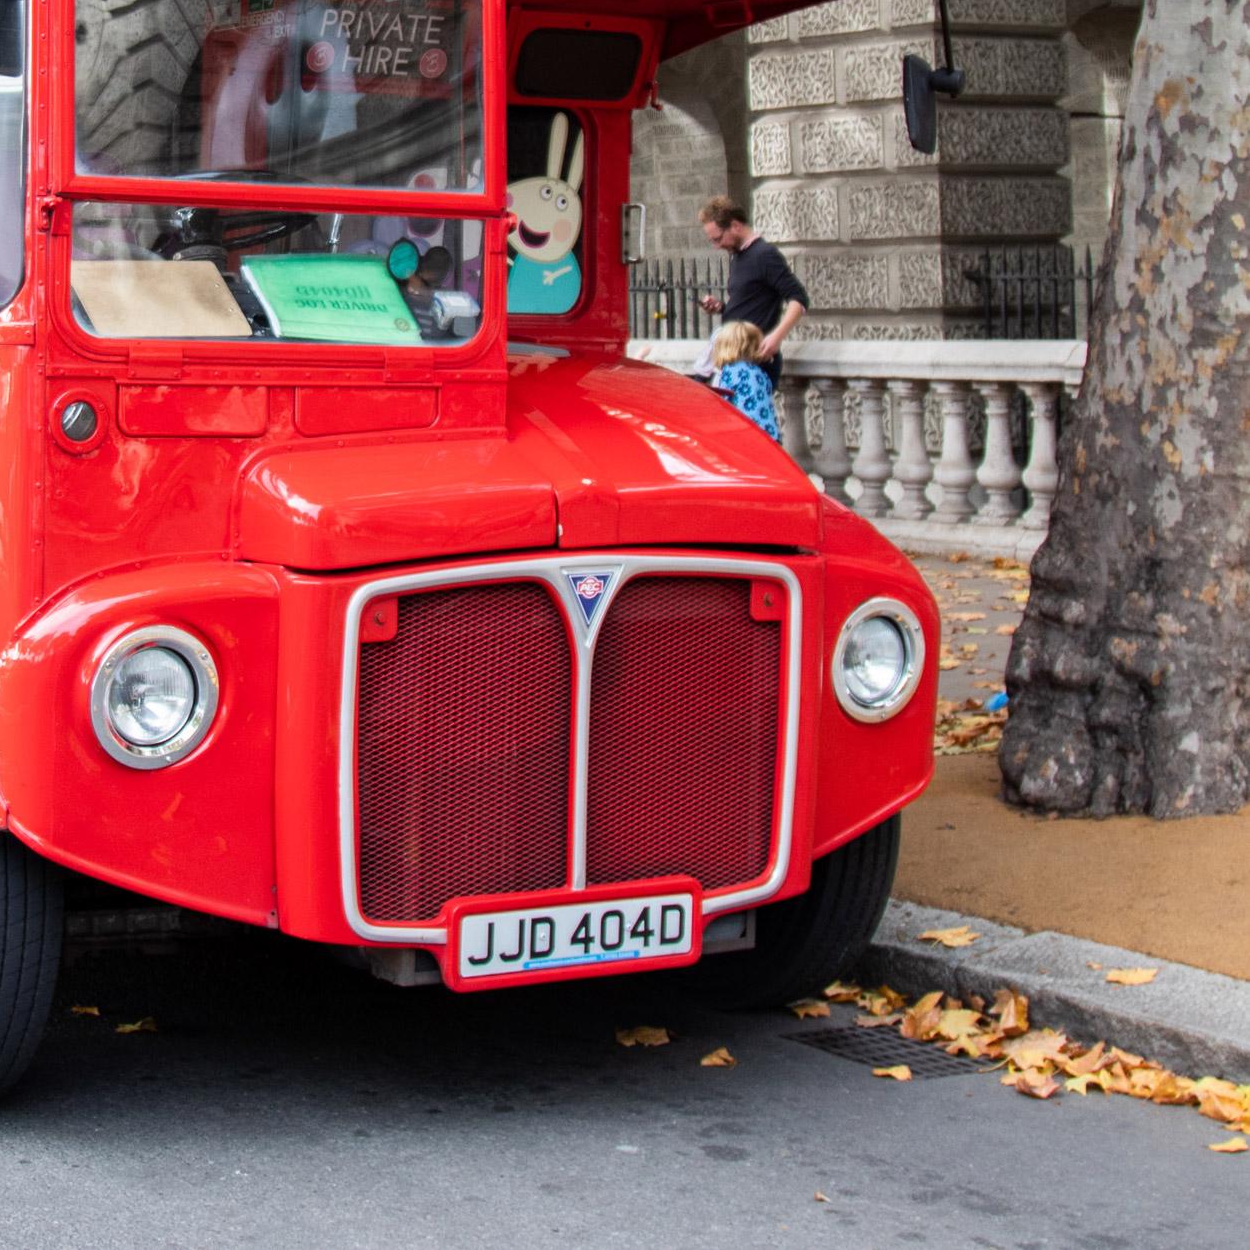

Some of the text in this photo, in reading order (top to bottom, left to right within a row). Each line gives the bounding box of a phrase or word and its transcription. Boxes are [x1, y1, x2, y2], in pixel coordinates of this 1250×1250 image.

[320, 9, 444, 44] PRIVATE
[342, 45, 413, 76] HIRE
[297, 298, 388, 313] DRIVER LOG
[468, 916, 555, 965] JJD
[570, 904, 685, 955] 404D
